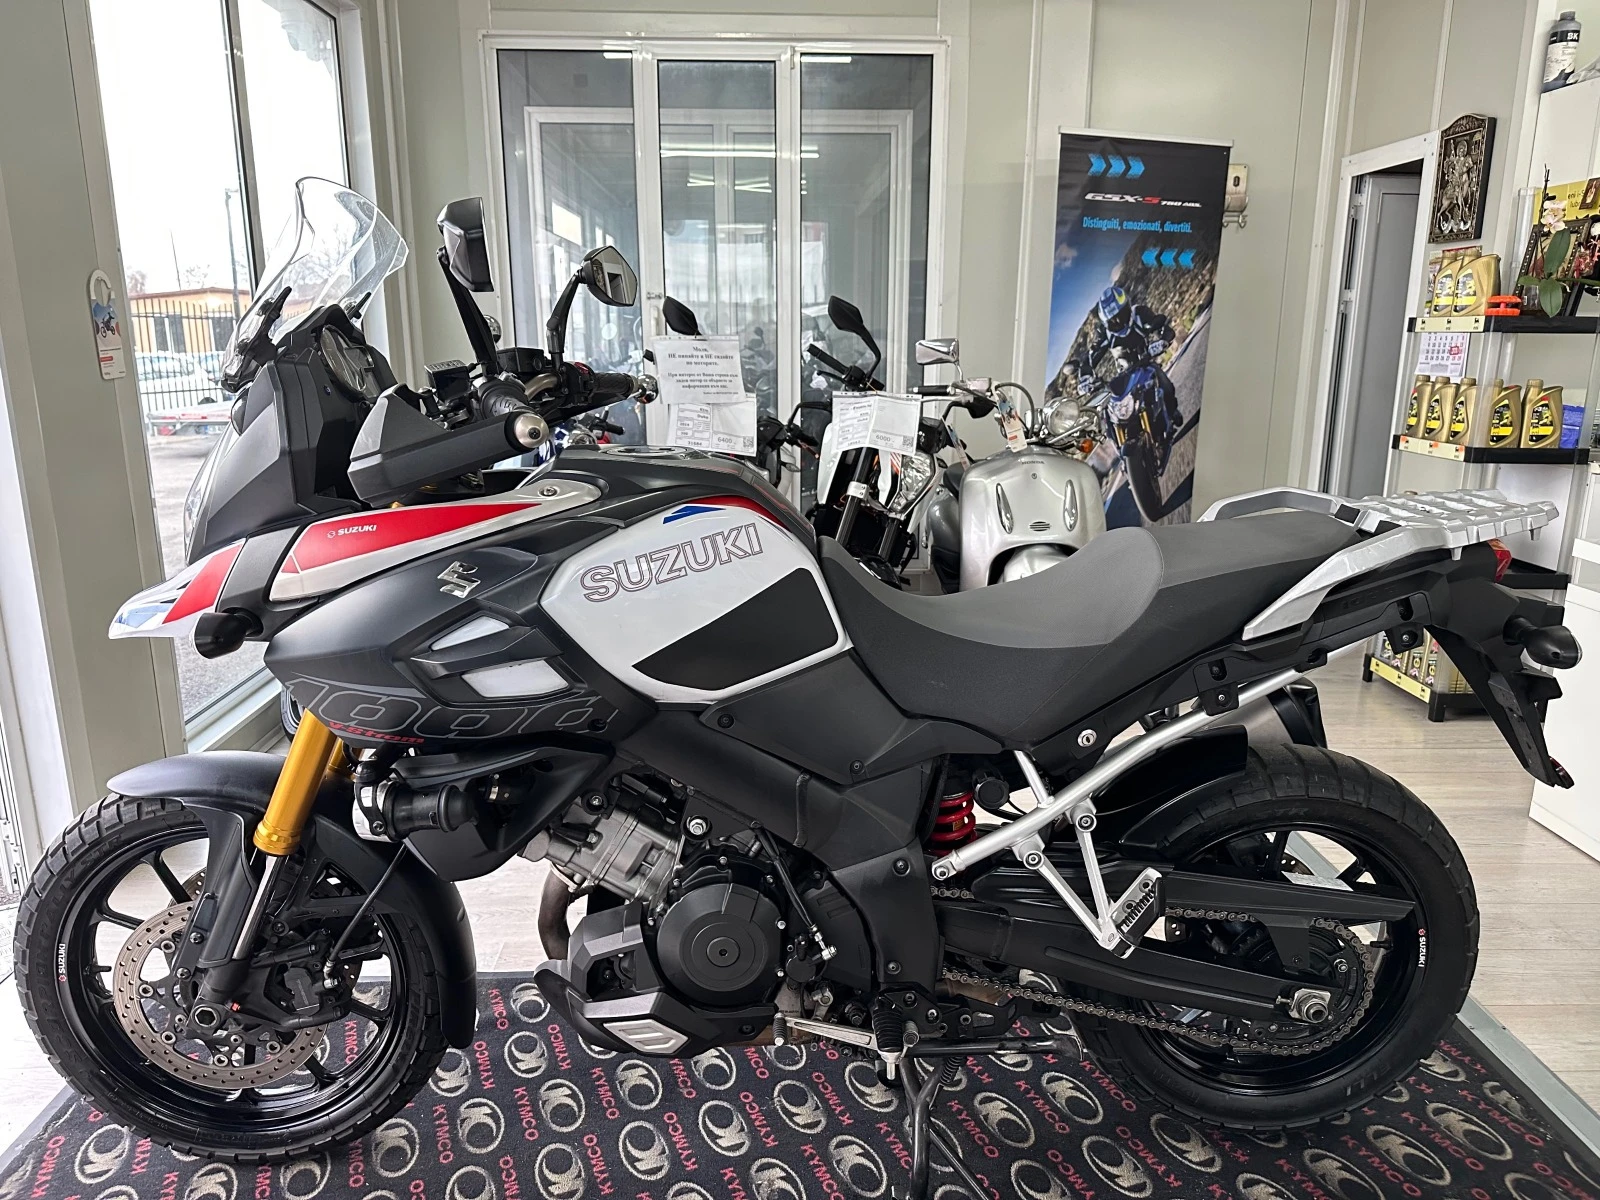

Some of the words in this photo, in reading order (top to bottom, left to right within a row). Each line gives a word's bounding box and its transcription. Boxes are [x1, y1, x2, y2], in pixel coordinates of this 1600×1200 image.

[1083, 217, 1121, 231] Distinguiti,
[1122, 220, 1162, 233] emozionati,
[1163, 220, 1192, 233] divertiti.
[717, 436, 733, 444] 6400
[876, 434, 890, 442] 6000
[337, 524, 377, 536] SUZUKI
[580, 522, 763, 603] SUZUKI
[285, 678, 618, 739] 1000
[58, 943, 66, 974] SUZUKI
[1418, 936, 1426, 967] SUZUKI
[487, 988, 509, 1030] KYMCO
[345, 1020, 358, 1063] KYMCO
[473, 1041, 494, 1089] KYMCO
[547, 1024, 571, 1070] KYMCO
[744, 1045, 770, 1079] MCO
[592, 1067, 620, 1120] KYMCO
[966, 1056, 991, 1083] KYM
[1080, 1060, 1136, 1111] KYMCO
[515, 1087, 539, 1141] KYMCO
[739, 1091, 777, 1148] KYMCO
[812, 1072, 852, 1126] KYMCO
[1016, 1080, 1070, 1132] KYMCO
[1461, 1090, 1544, 1146] KYMCO
[433, 1104, 454, 1164] KYMCO
[663, 1112, 697, 1171] KYMCO
[876, 1122, 912, 1170] KYMC
[949, 1100, 999, 1158] KYMCO
[1402, 1113, 1483, 1171] KYMCO
[31, 1136, 66, 1200] KYMCO
[132, 1138, 151, 1174] KYM
[499, 1155, 519, 1200] MCO
[583, 1133, 614, 1195] KYMCO
[1046, 1149, 1095, 1200] YMCO
[1117, 1127, 1181, 1187] KYMCO
[1341, 1136, 1421, 1196] KYMCO
